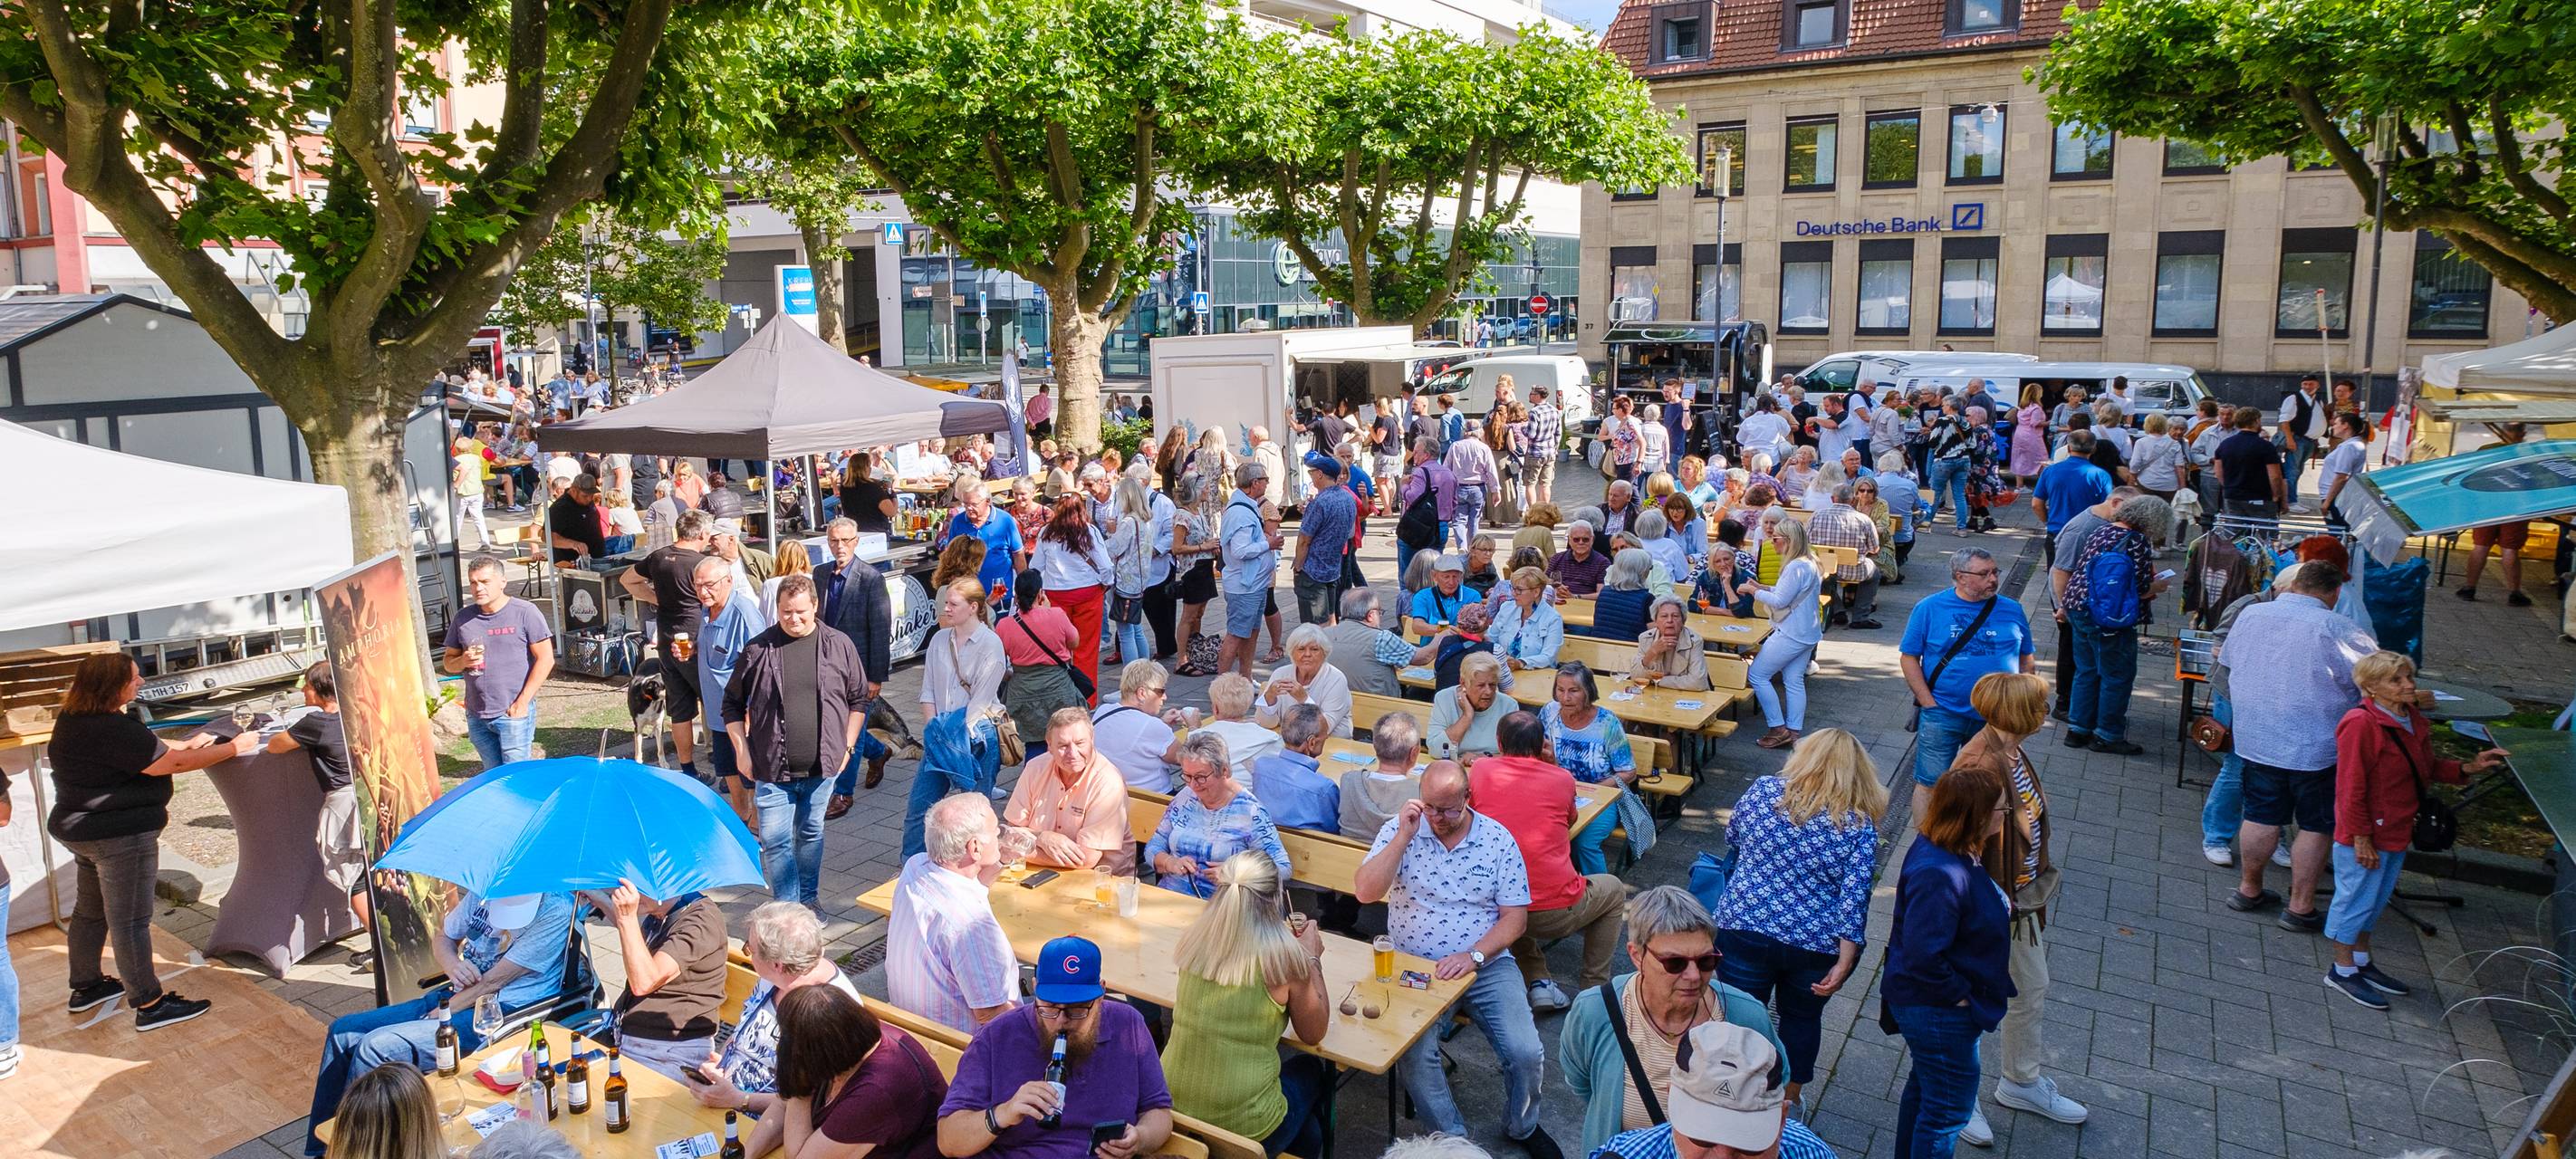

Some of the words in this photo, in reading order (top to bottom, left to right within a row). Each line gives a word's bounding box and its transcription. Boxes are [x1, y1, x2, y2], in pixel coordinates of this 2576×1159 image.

[1796, 218, 1886, 236] Deutsche
[1891, 216, 1942, 232] Bank
[339, 618, 402, 666] AMPHORIA
[152, 687, 168, 697] MH
[169, 683, 188, 694] 157
[473, 906, 490, 921] VAN
[1063, 955, 1080, 973] C
